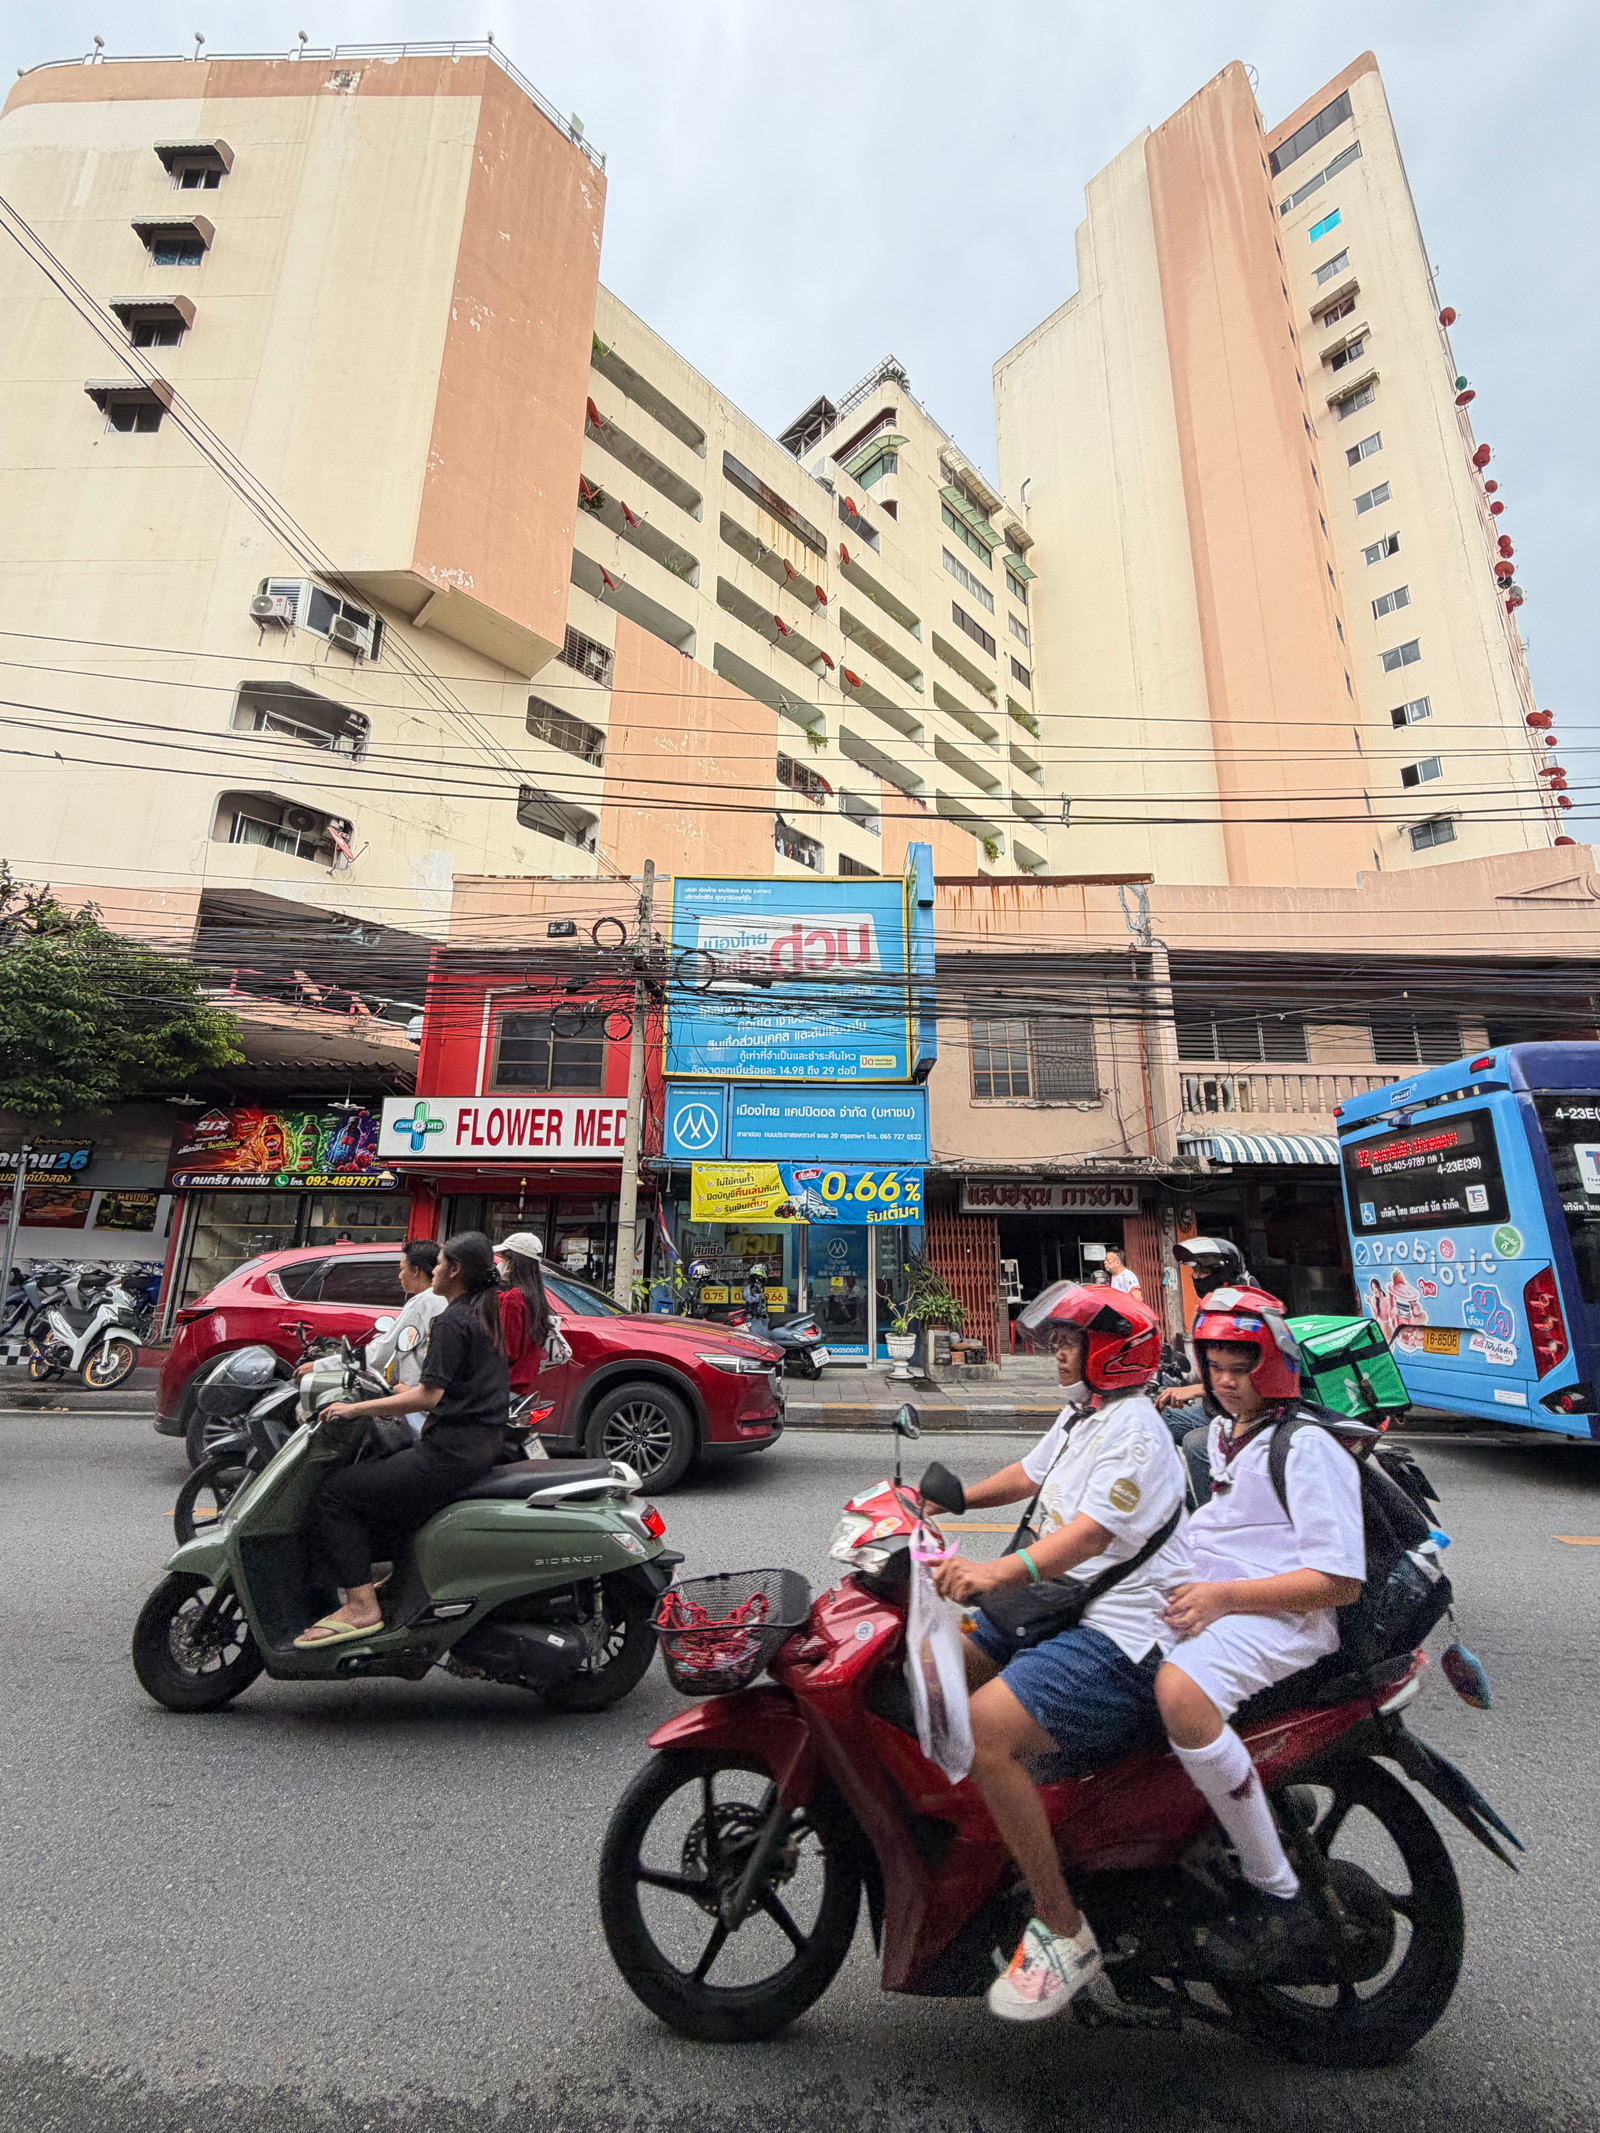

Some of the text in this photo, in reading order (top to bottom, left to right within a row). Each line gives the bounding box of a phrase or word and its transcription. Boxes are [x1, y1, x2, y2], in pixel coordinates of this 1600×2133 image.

[779, 1066, 804, 1076] 14.98
[807, 1064, 820, 1076] ถึง
[822, 1066, 834, 1076] 29
[837, 1064, 857, 1076] ต่อปี
[736, 1103, 916, 1120] เมืองไทย แคปปิตอล จำกัด (มหาชน)
[1555, 1107, 1600, 1121] 4-23E(
[195, 1120, 231, 1131] SIX
[456, 1107, 627, 1147] FLOWER MED
[1383, 1156, 1425, 1172] 02-405-9789
[1437, 1155, 1482, 1175] 4-23E(39)
[305, 1175, 379, 1187] 092-4697971
[821, 1171, 921, 1202] 0.66 %
[1442, 1198, 1460, 1210] จำกัด
[866, 1202, 919, 1223] รับเต็มๆ
[1372, 1237, 1497, 1286] Probiotic
[704, 1292, 724, 1301] 0.75
[1426, 1332, 1458, 1348] 16-8506
